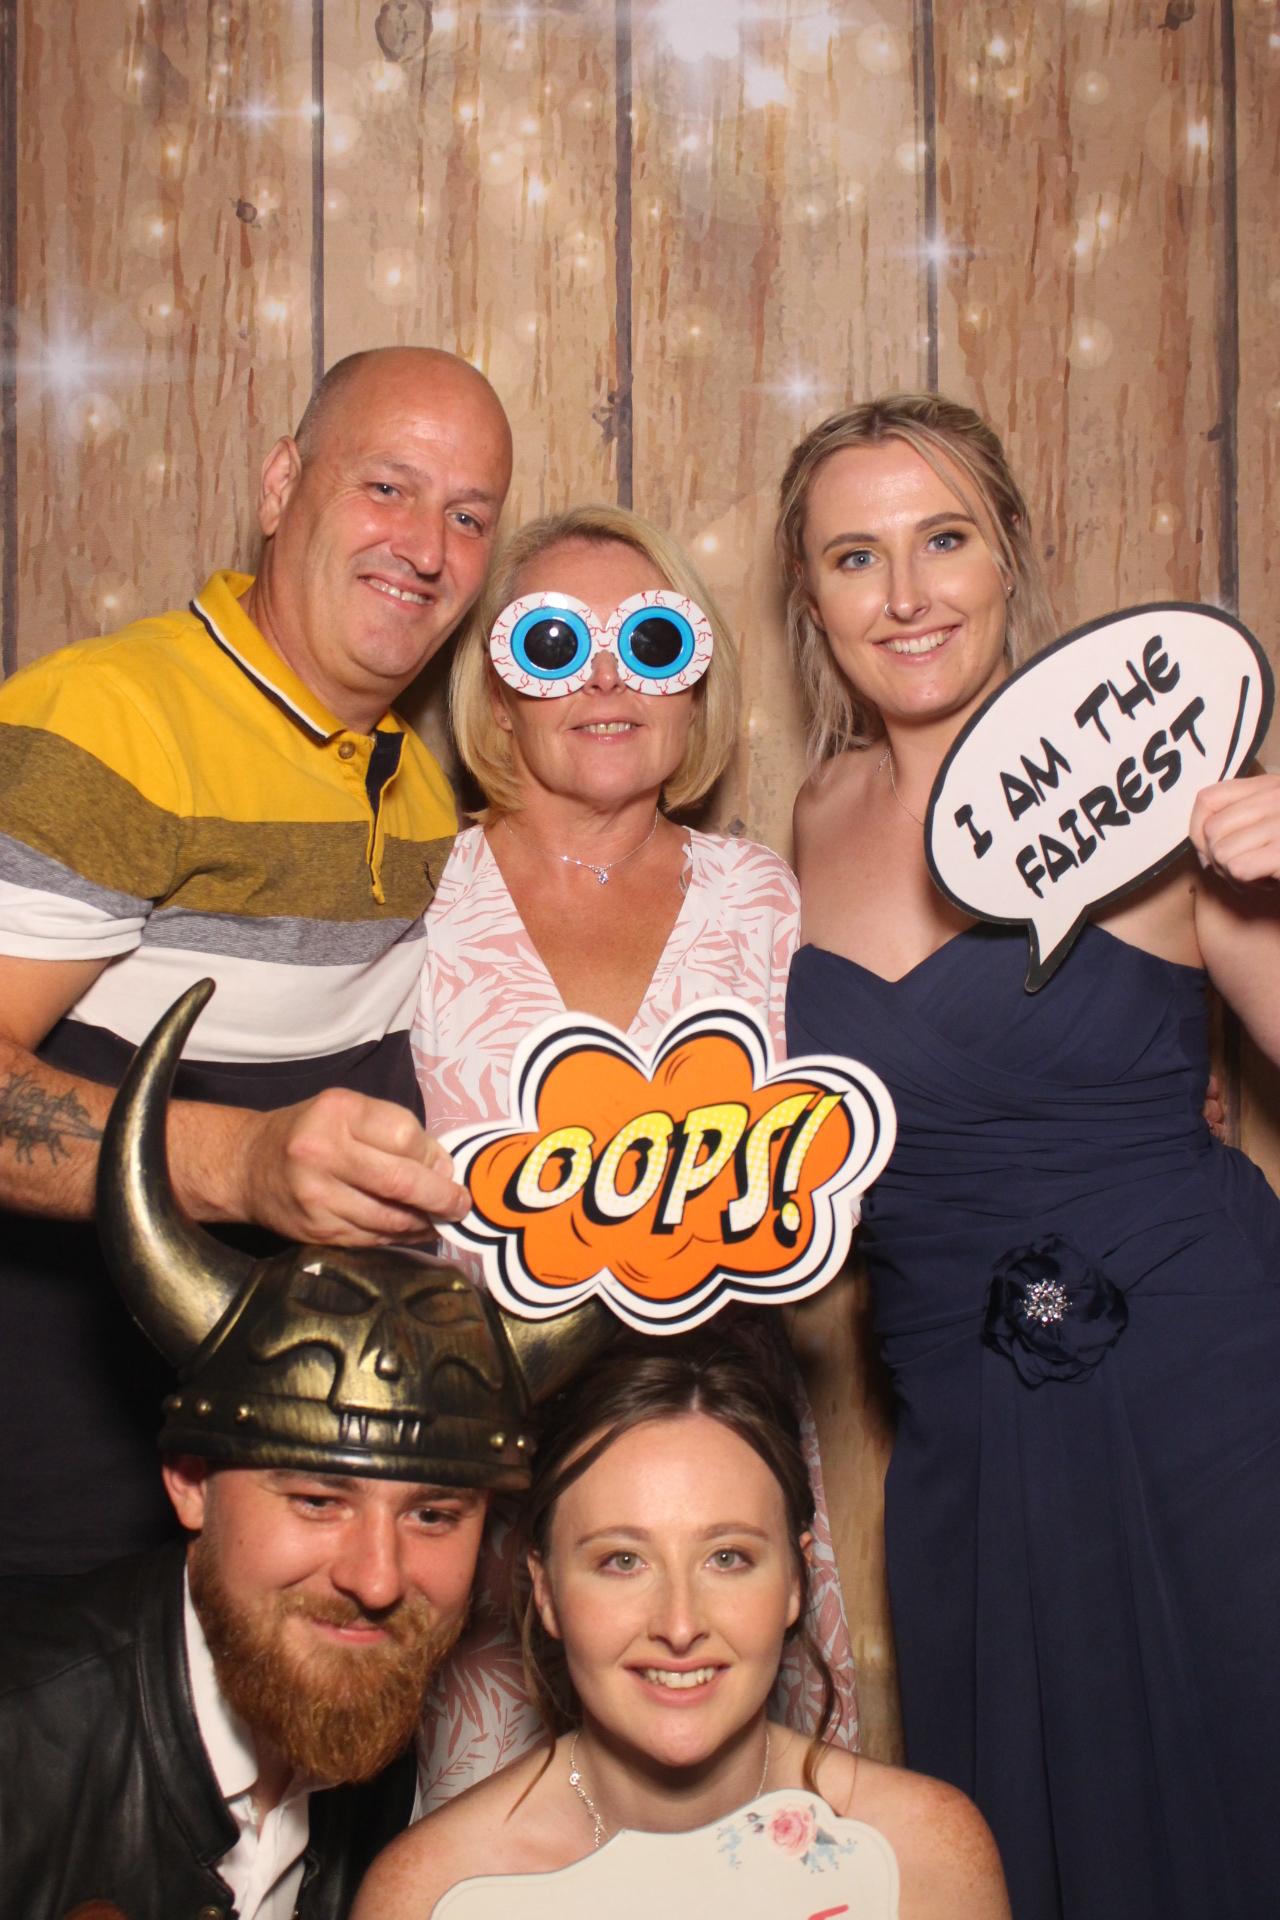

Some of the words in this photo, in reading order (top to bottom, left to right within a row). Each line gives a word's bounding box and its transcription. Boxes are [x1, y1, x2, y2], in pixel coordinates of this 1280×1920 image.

[954, 804, 992, 859] I
[1000, 737, 1072, 821] AM
[1074, 635, 1180, 743] THE
[1015, 696, 1206, 898] FAIREST
[503, 1091, 848, 1248] OOPS!
